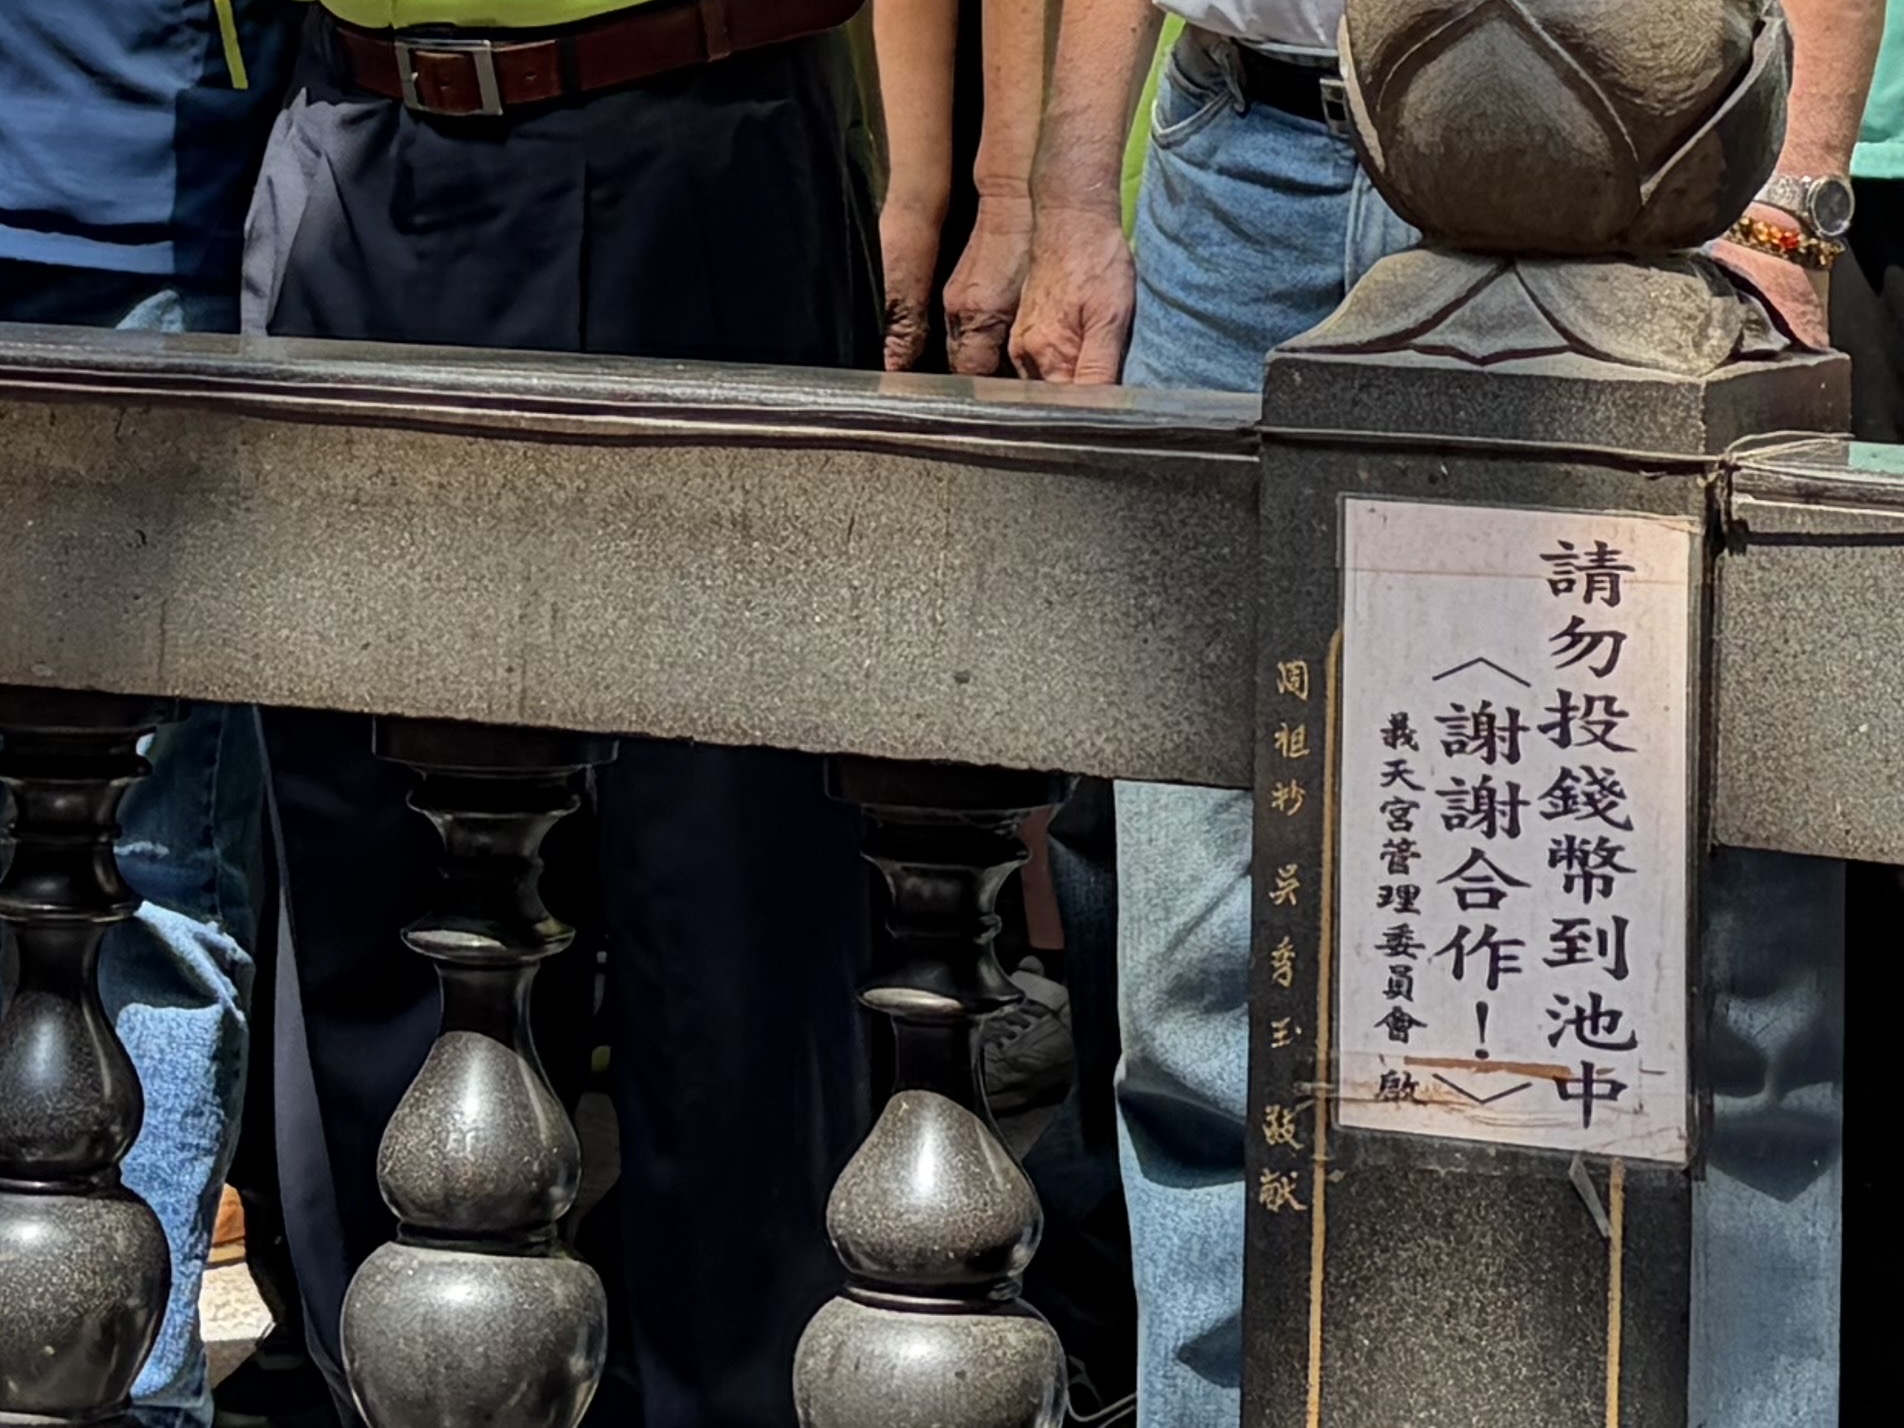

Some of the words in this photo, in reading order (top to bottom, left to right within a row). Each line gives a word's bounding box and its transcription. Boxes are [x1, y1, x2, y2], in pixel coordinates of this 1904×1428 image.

[1374, 711, 1429, 1044] 義天宮管理委員會
[1536, 539, 1638, 1129] 請勿投錢幣到池中
